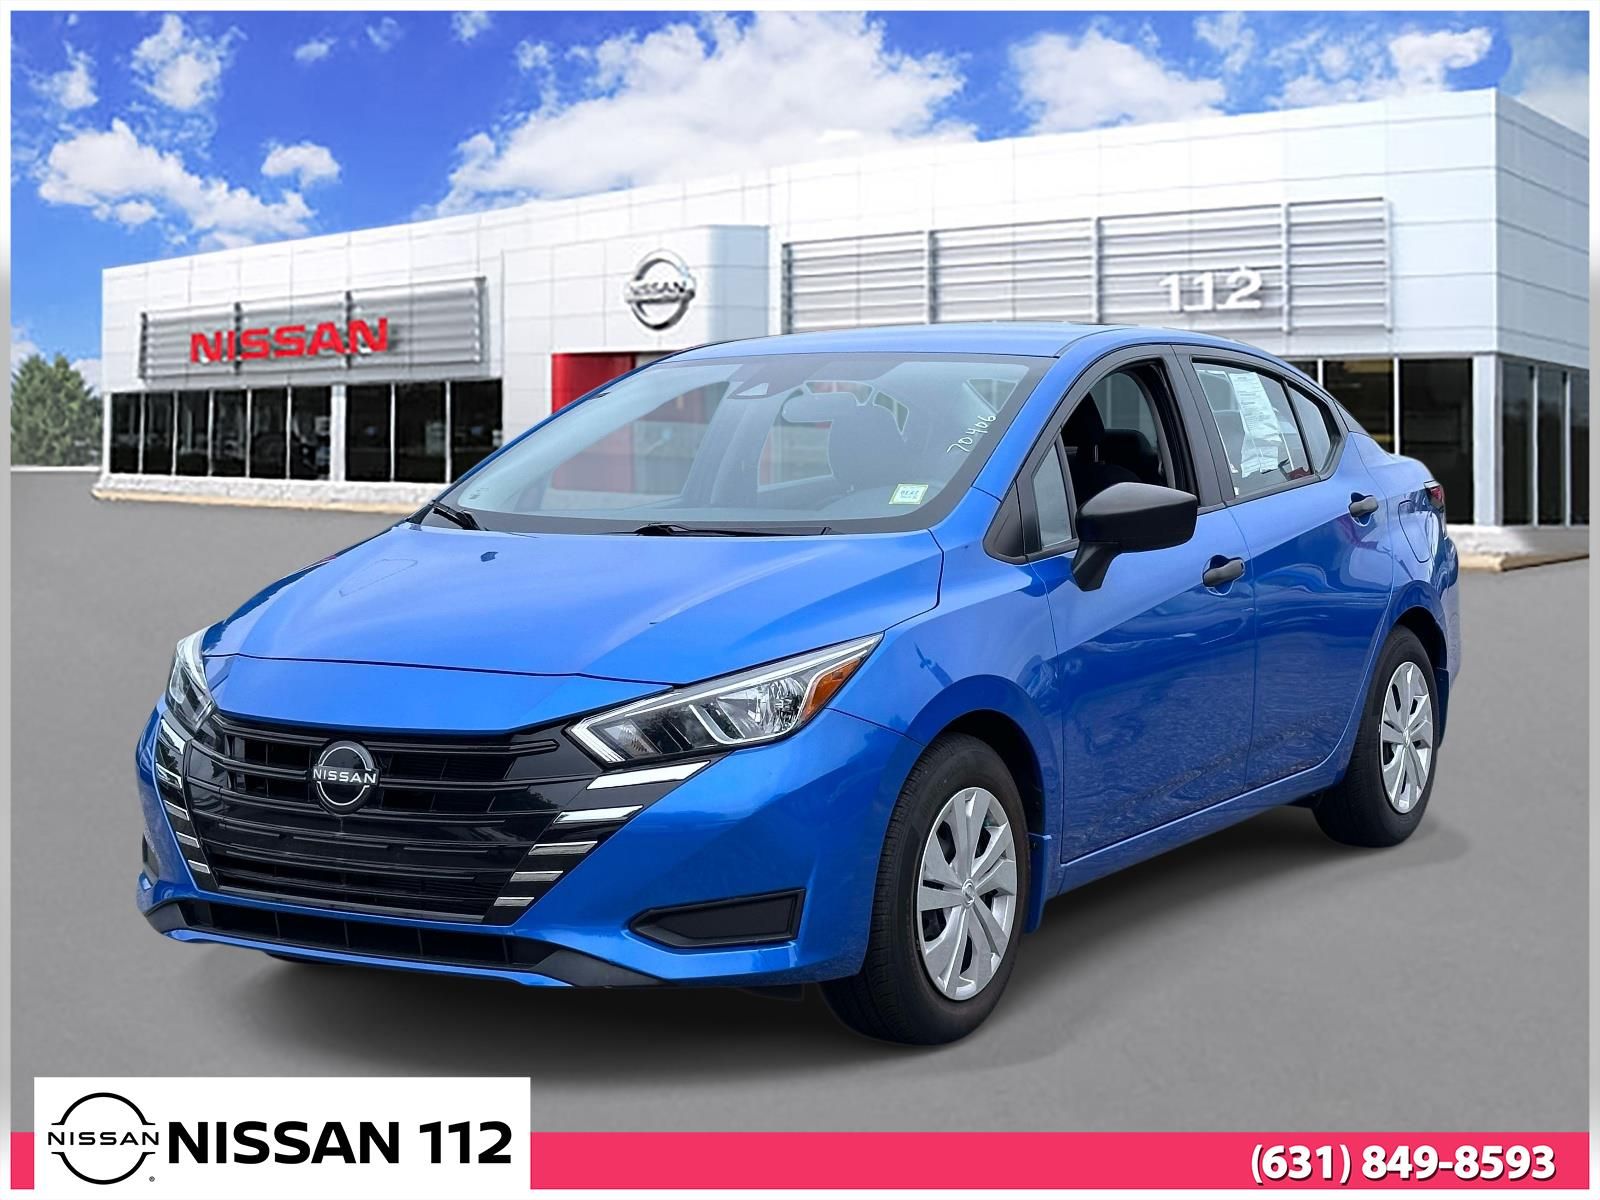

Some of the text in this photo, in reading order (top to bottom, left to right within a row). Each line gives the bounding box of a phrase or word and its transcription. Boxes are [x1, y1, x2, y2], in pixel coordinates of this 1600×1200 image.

[1158, 270, 1262, 312] 112
[190, 317, 389, 363] NISSAN
[946, 415, 997, 453] 70406
[313, 768, 377, 784] NISSAN
